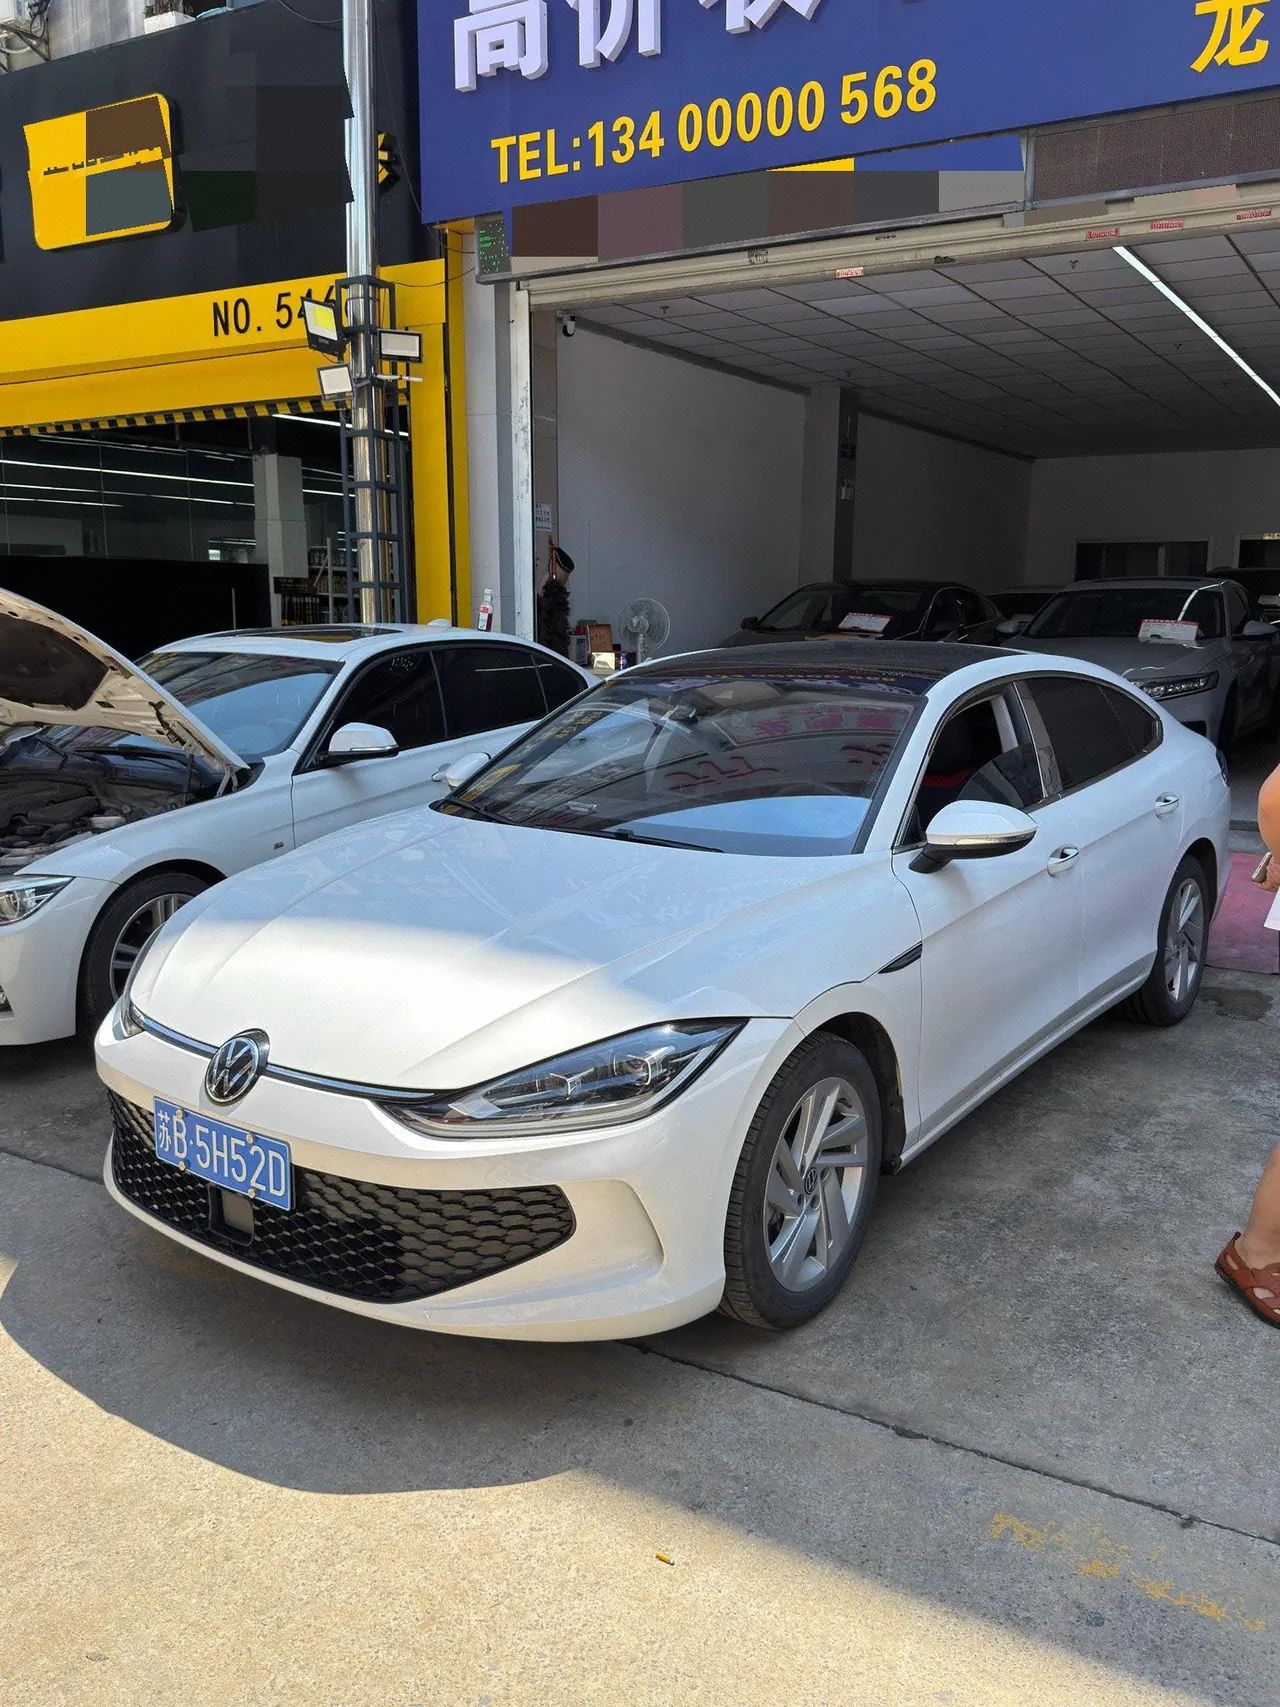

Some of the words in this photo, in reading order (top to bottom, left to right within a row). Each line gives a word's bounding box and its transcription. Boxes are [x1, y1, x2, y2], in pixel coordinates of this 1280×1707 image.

[490, 110, 665, 183] TEL:134
[678, 80, 825, 152] 00000
[840, 58, 937, 124] 568
[212, 298, 262, 337] NO.
